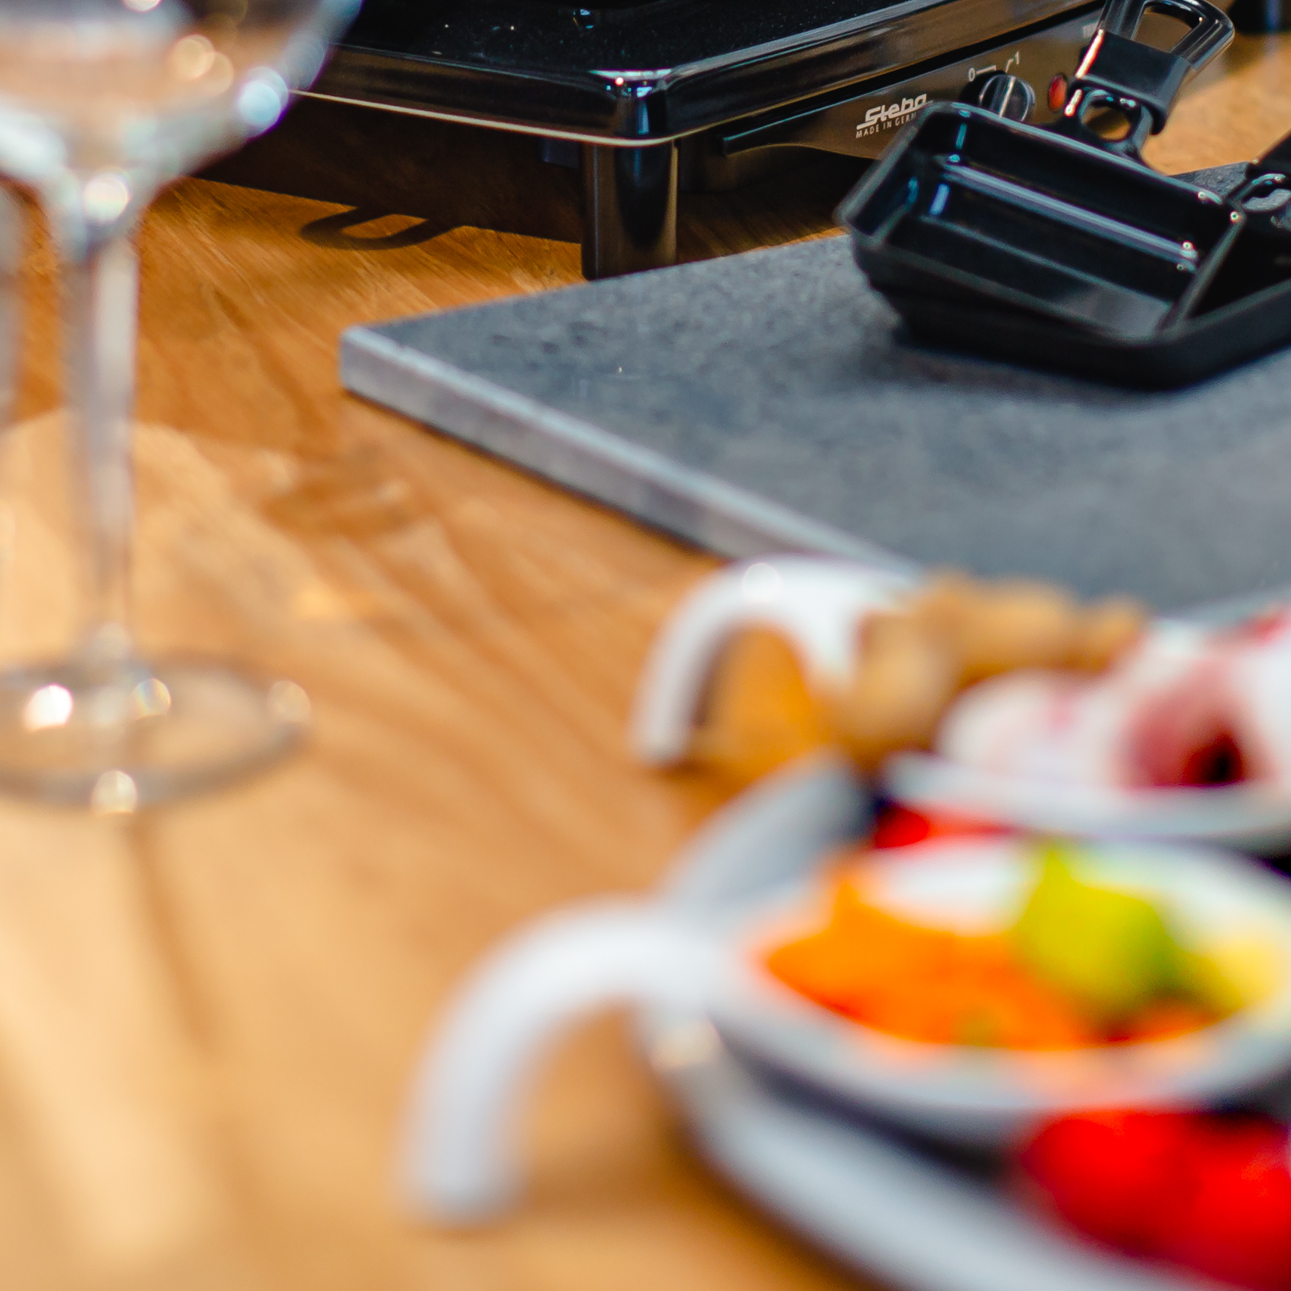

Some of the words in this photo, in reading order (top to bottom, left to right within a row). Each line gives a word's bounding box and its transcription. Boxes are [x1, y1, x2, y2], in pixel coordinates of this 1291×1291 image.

[856, 93, 933, 130] Steba
[856, 124, 879, 139] MADE
[883, 120, 892, 130] IN
